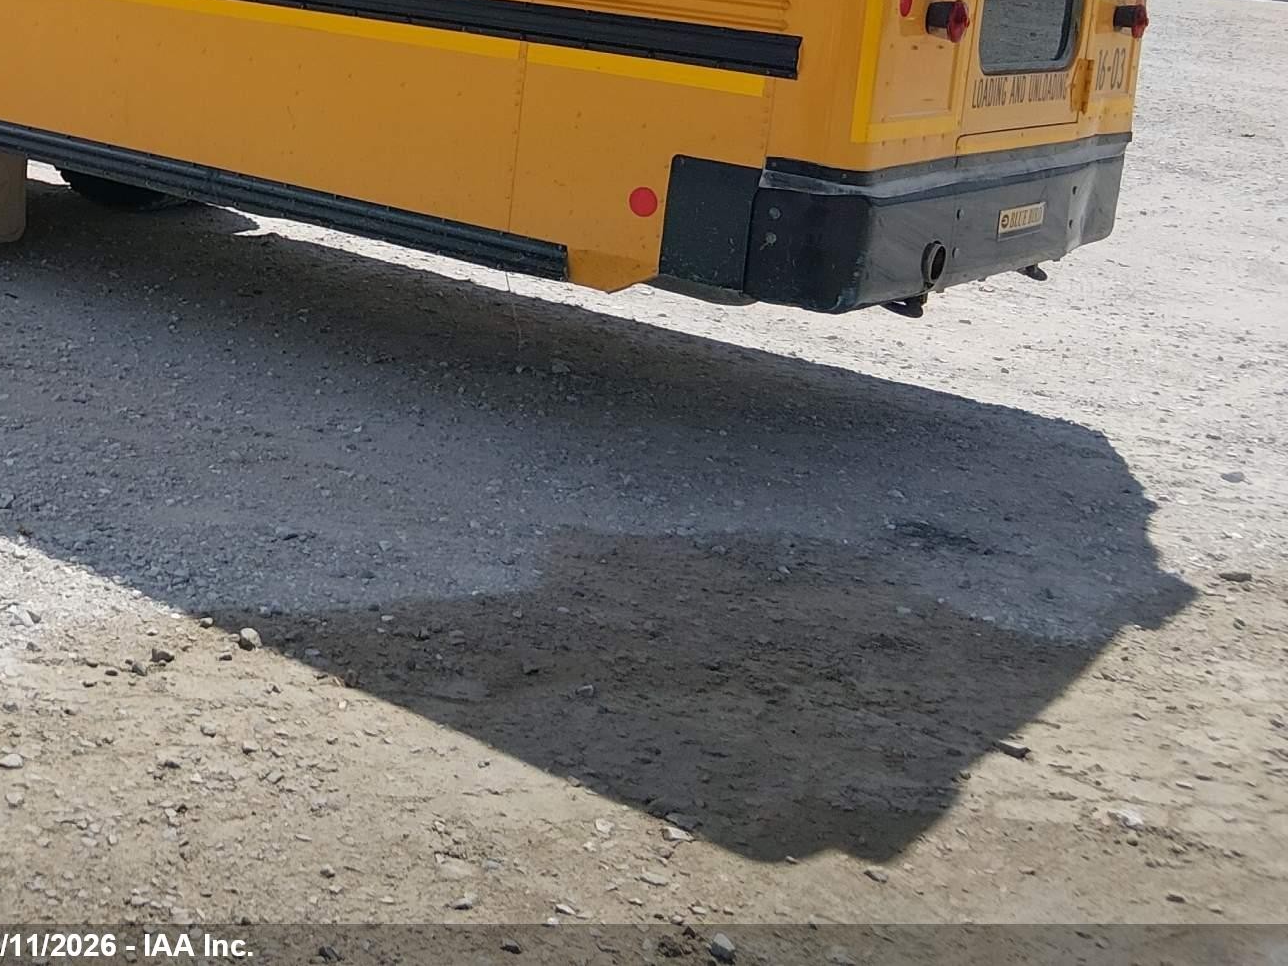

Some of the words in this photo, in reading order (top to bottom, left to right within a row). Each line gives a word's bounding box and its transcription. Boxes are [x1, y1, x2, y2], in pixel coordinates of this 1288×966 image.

[1095, 47, 1127, 91] 16-03
[971, 76, 1009, 109] LOADING
[1008, 75, 1027, 104] AND
